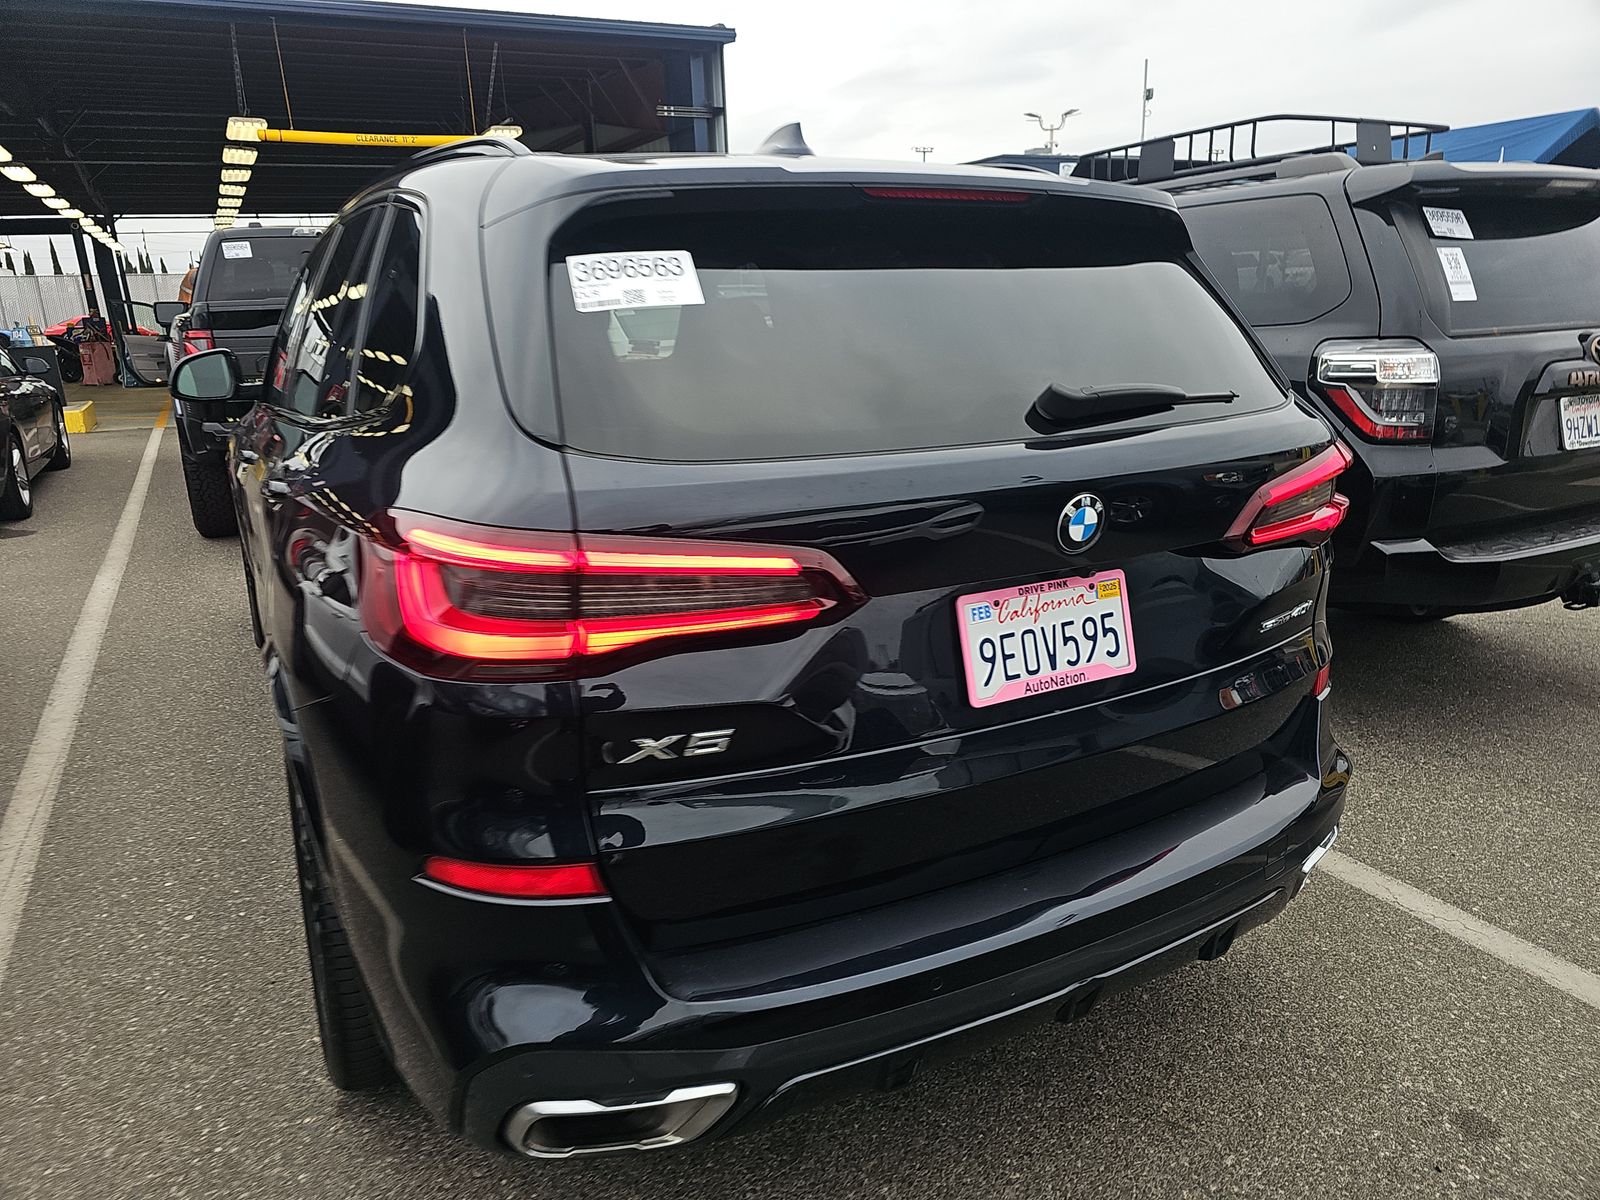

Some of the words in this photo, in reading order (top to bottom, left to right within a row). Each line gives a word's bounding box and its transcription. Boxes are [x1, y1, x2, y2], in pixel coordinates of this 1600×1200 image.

[355, 134, 398, 143] CLEARANCE
[1577, 394, 1600, 406] TOYOTA
[1064, 496, 1104, 517] BMW
[1017, 585, 1046, 597] DRIVE
[1047, 579, 1069, 591] PINK
[970, 605, 992, 622] FEB
[997, 593, 1097, 625] California
[616, 728, 737, 765] X5
